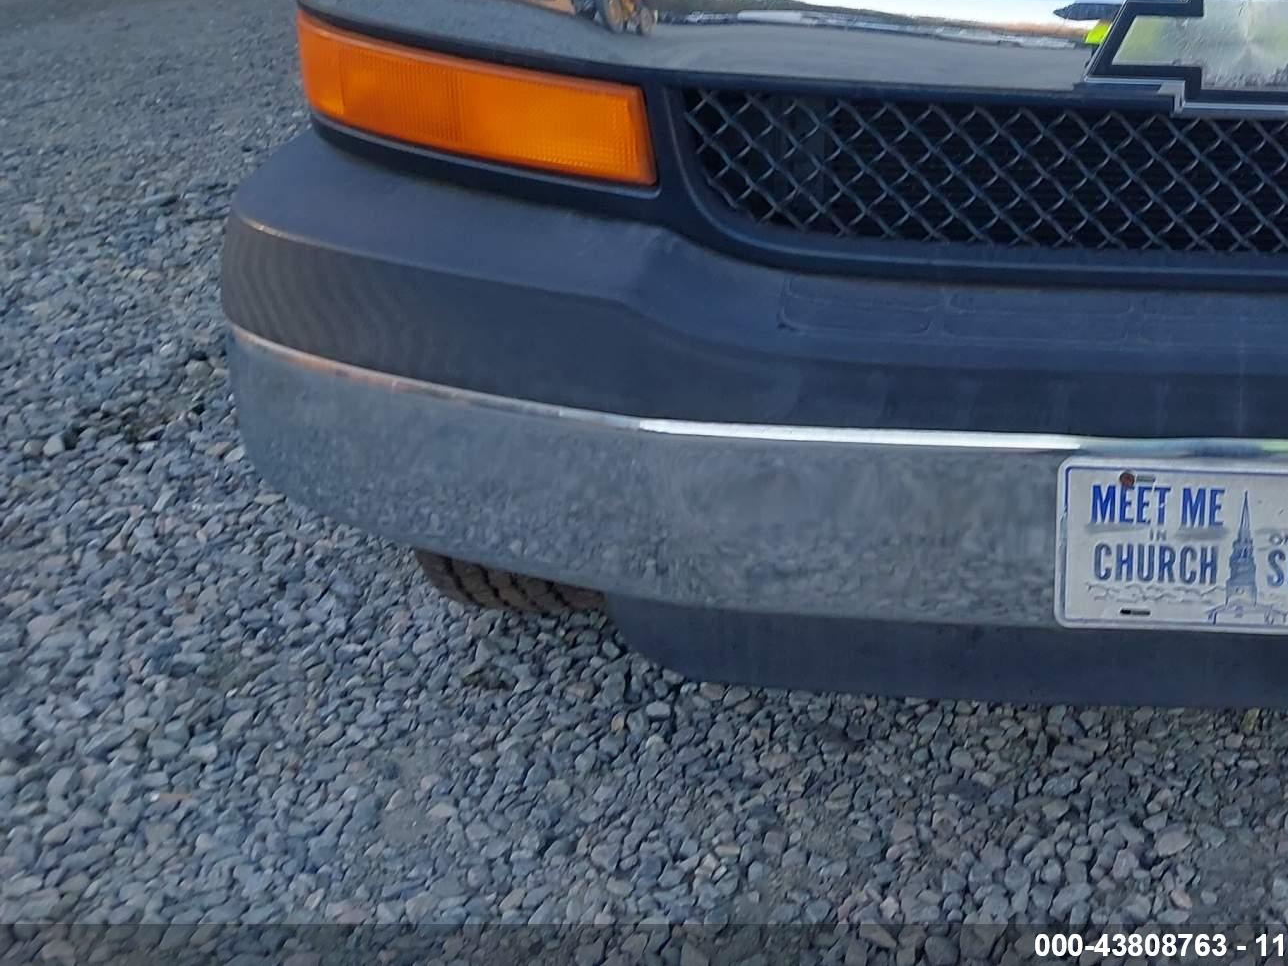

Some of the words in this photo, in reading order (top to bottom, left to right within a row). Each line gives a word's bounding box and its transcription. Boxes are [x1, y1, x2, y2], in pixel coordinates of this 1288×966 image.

[1091, 484, 1171, 525] MEET
[1181, 486, 1226, 527] ME
[1149, 529, 1167, 541] IN
[1093, 542, 1218, 585] CHURCH
